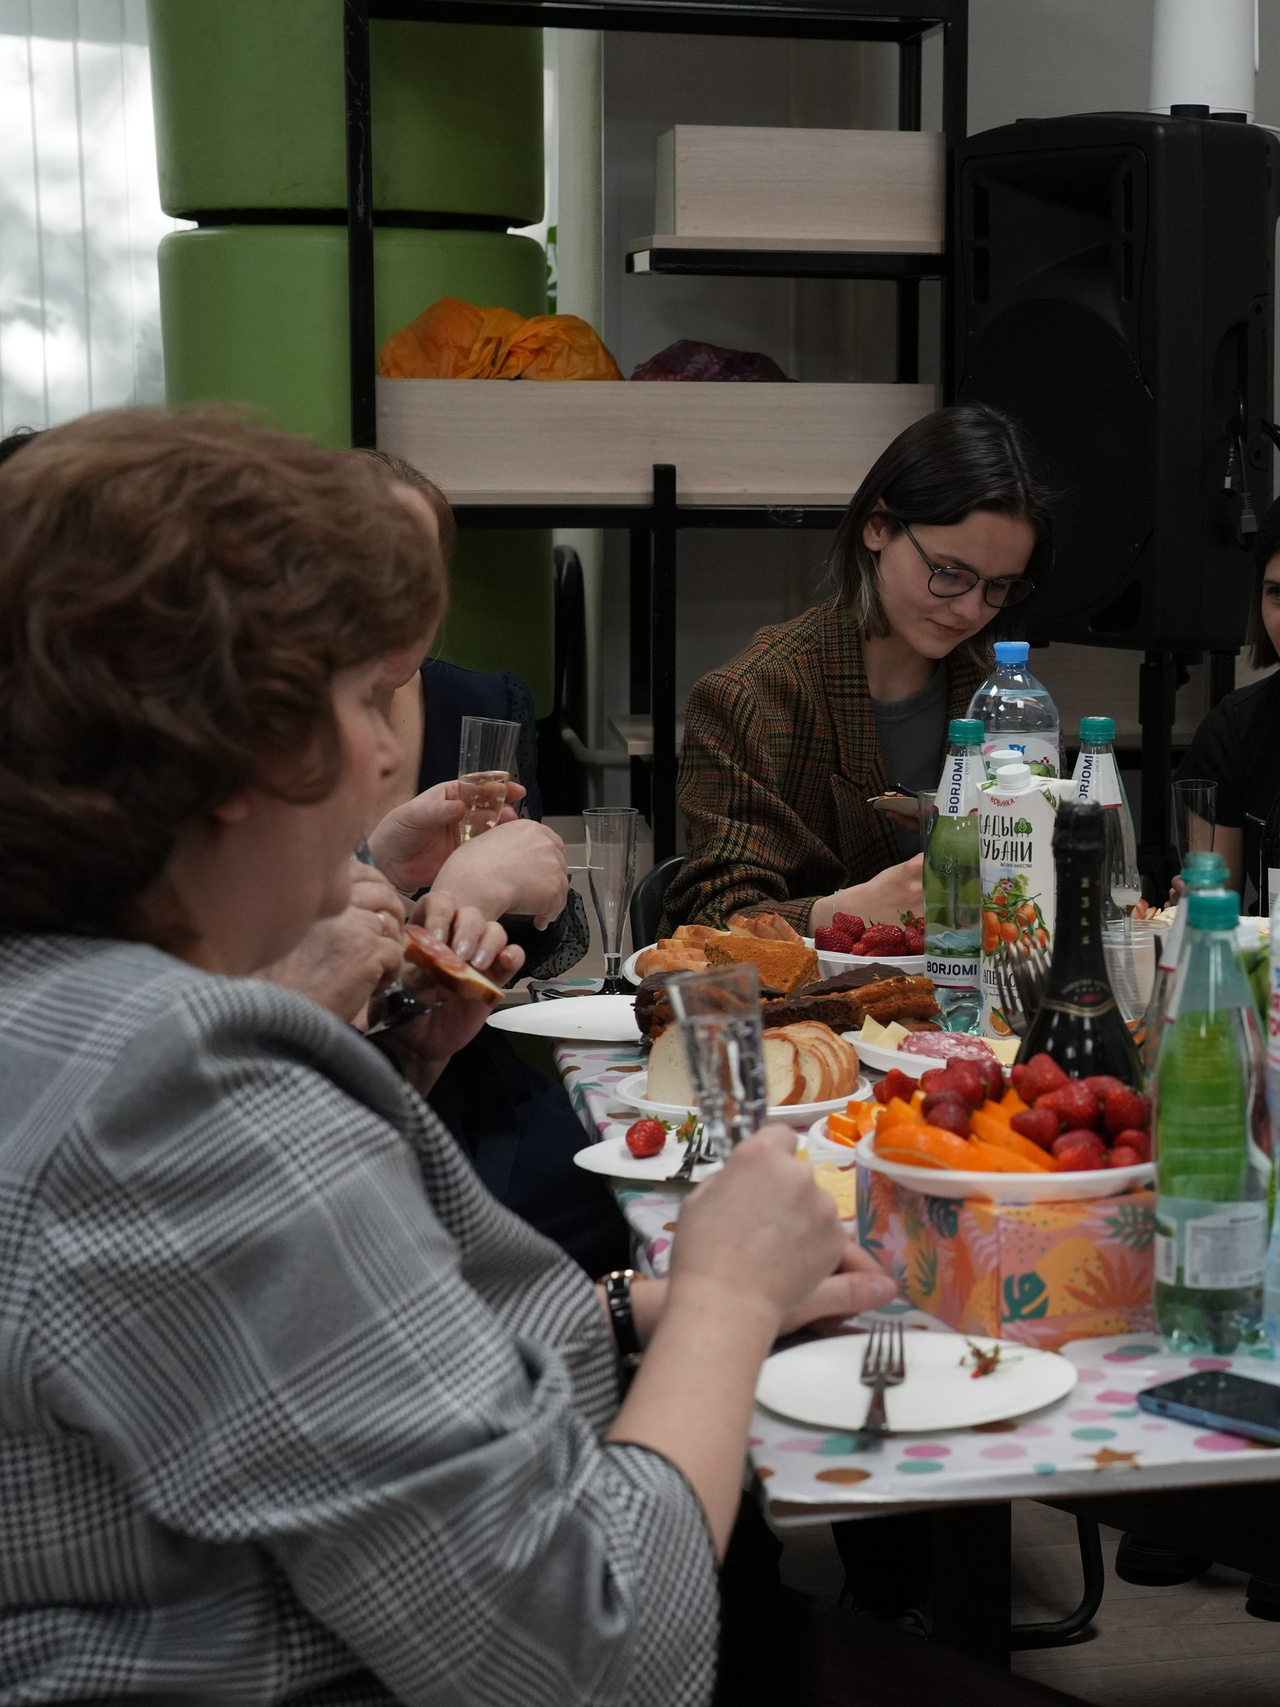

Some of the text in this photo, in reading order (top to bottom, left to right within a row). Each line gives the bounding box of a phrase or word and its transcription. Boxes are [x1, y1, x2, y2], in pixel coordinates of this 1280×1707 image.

[948, 758, 964, 814] BORJOMI
[1078, 755, 1094, 800] ORJOMI
[926, 960, 978, 976] BORJOMI
